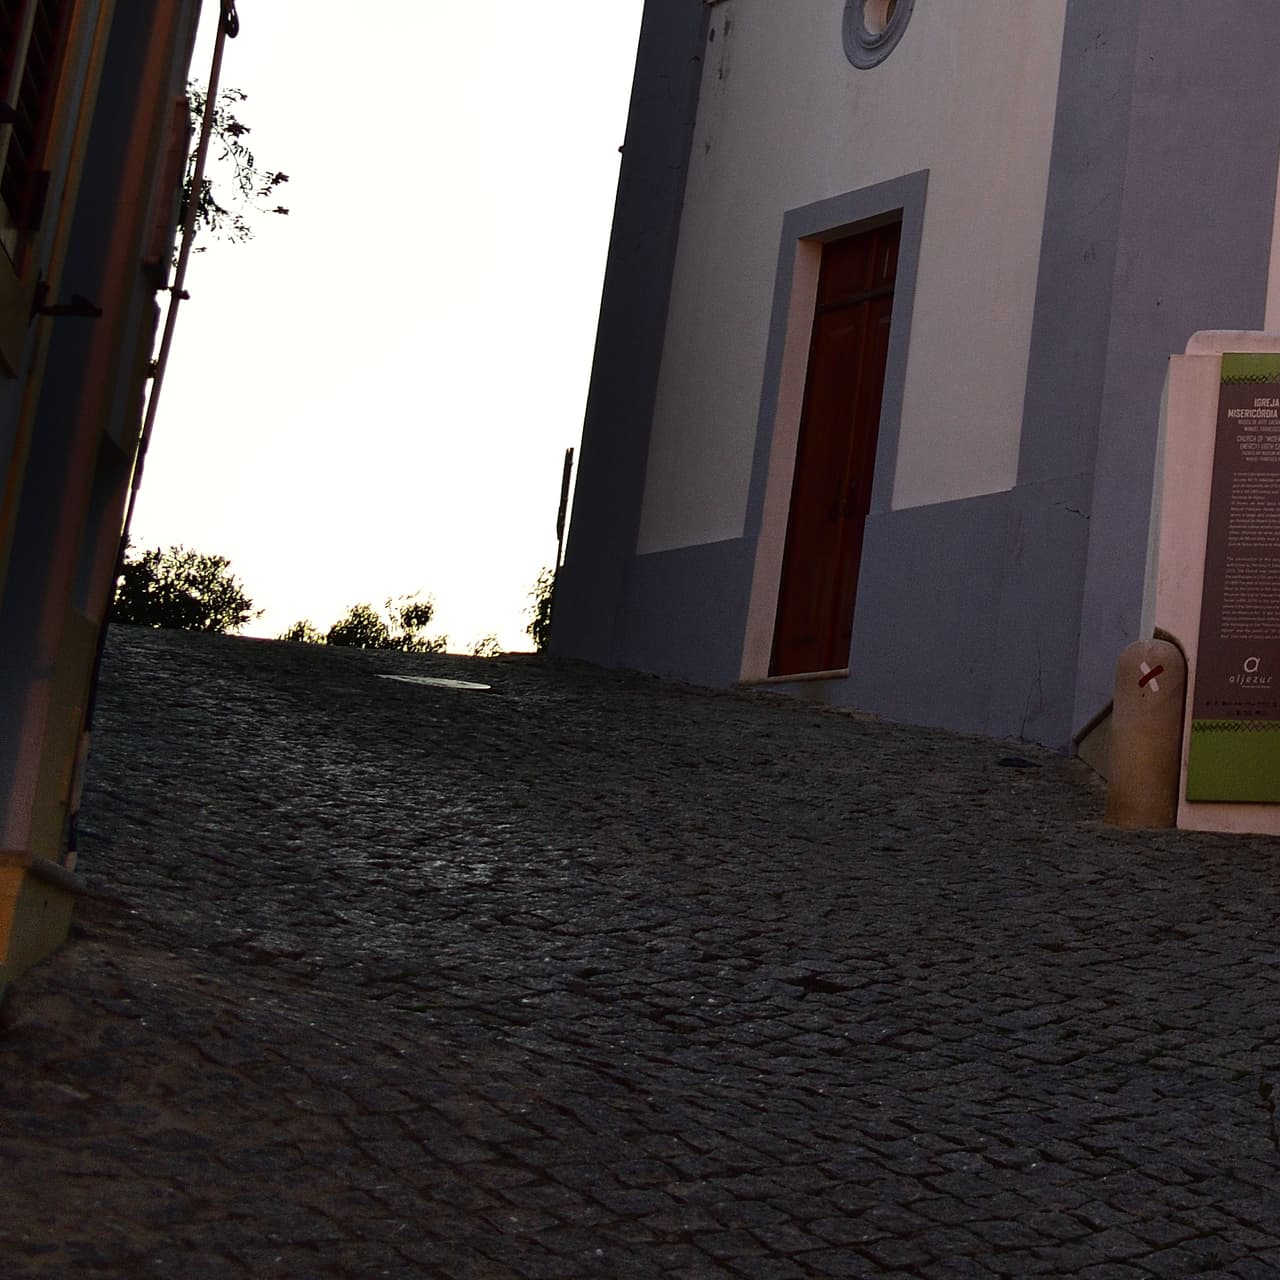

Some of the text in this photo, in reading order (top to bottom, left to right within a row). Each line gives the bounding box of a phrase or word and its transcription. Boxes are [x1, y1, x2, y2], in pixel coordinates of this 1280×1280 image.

[1254, 398, 1280, 408] IGREJA
[1227, 408, 1278, 419] MISERICÓRDIA
[1229, 673, 1273, 686] aljezur
